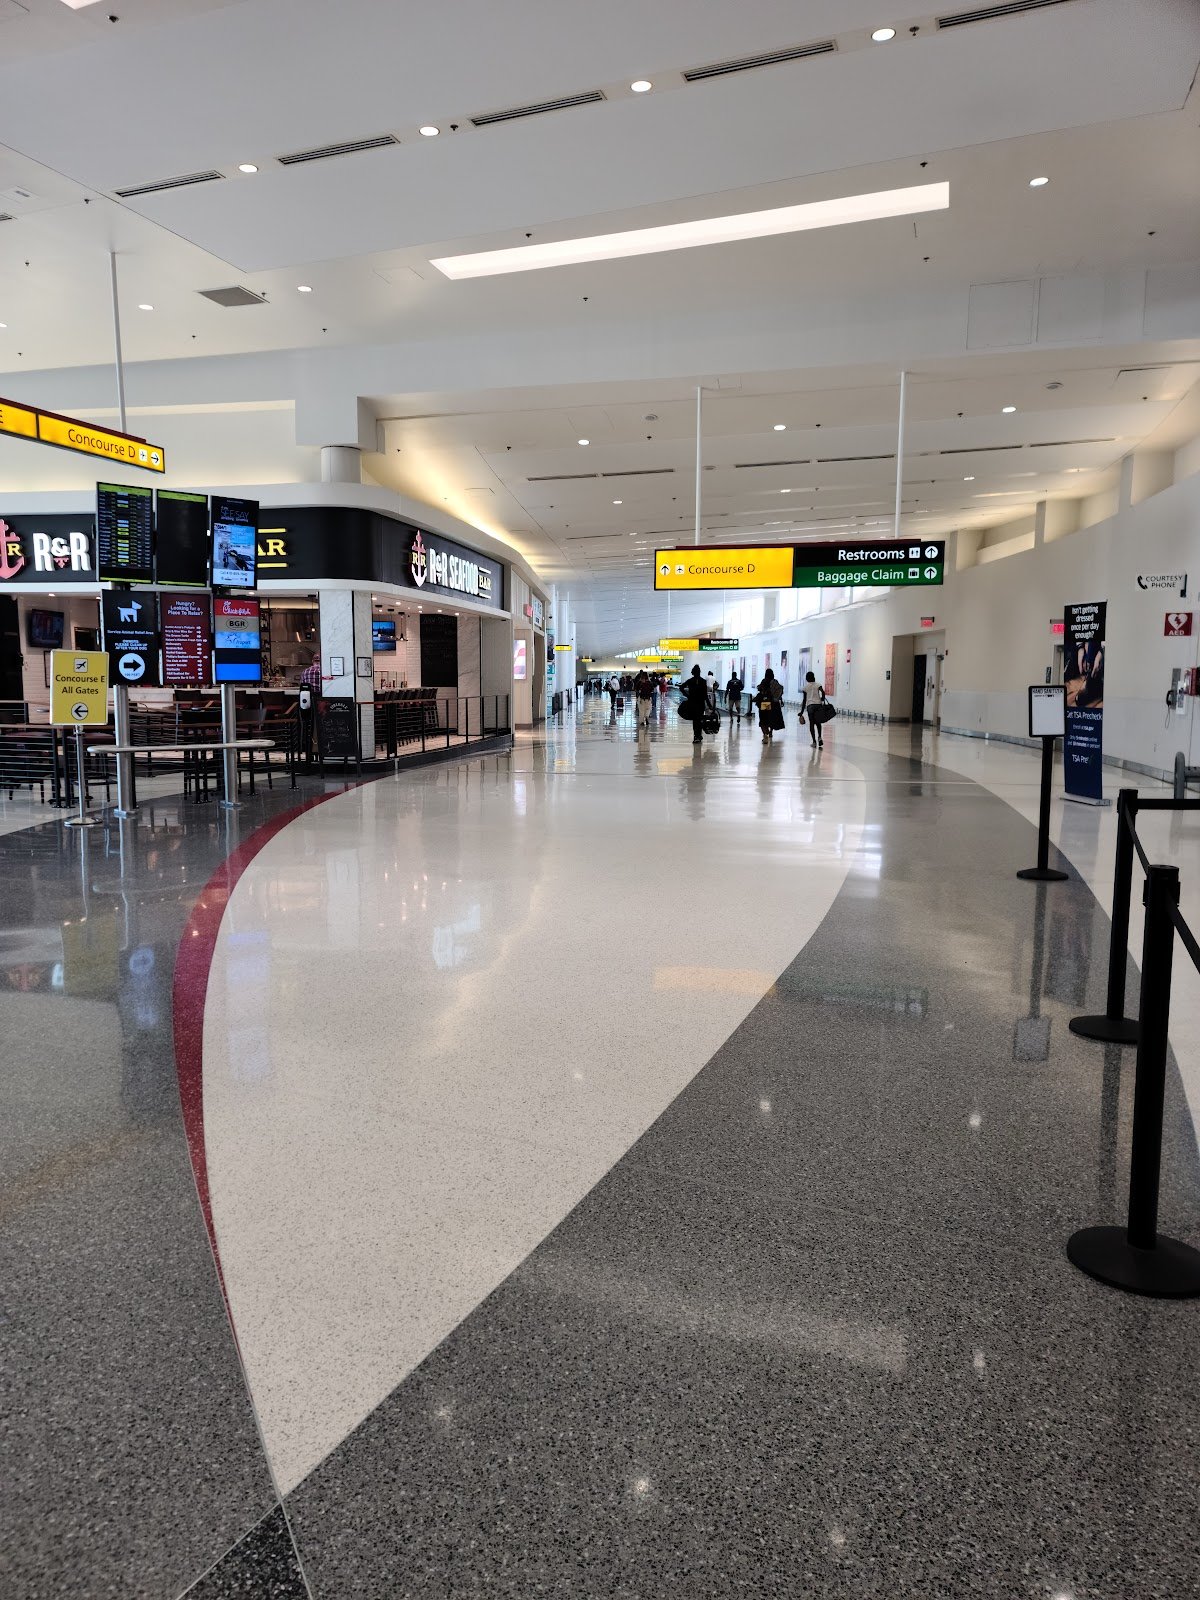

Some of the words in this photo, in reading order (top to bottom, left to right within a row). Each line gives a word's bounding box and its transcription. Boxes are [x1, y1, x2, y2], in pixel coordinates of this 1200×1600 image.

[68, 429, 124, 456] Concourse
[128, 446, 135, 457] D
[32, 532, 92, 572] R&R
[838, 550, 904, 560] Restrooms
[430, 548, 448, 587] R&R
[450, 555, 478, 595] SEAFOOD
[479, 574, 491, 590] BAR
[688, 565, 744, 574] Concourse
[748, 564, 755, 573] D
[817, 571, 868, 583] Baggage
[872, 569, 904, 580] Claim
[1082, 605, 1098, 615] getting
[1076, 614, 1094, 622] dressed
[1090, 622, 1099, 630] day
[1075, 631, 1094, 639] enough?
[1072, 754, 1080, 762] TSA
